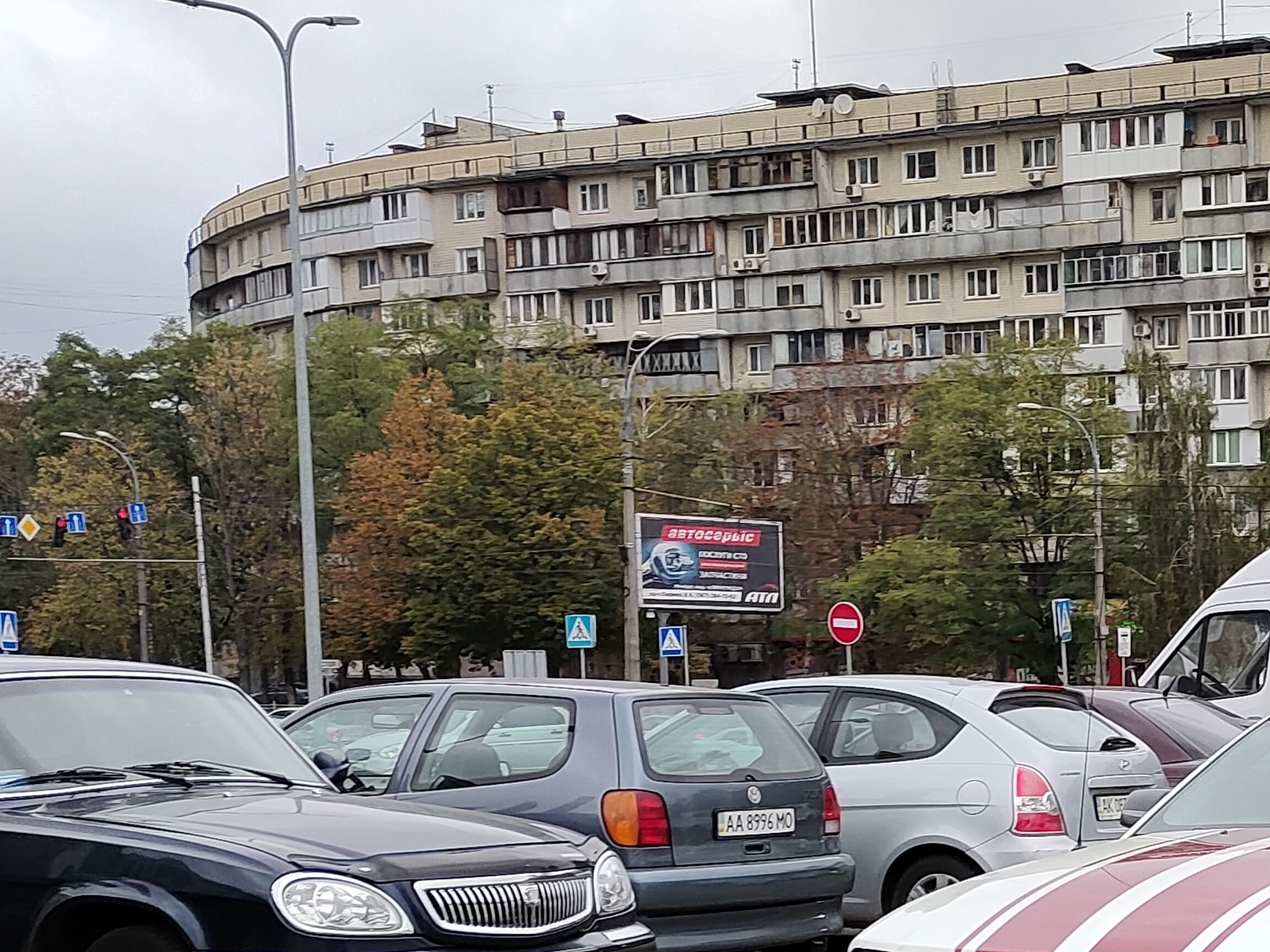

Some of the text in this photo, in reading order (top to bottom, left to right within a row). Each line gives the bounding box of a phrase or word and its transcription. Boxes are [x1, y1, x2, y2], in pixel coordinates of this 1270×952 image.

[726, 812, 793, 832] AA 8996 MO
